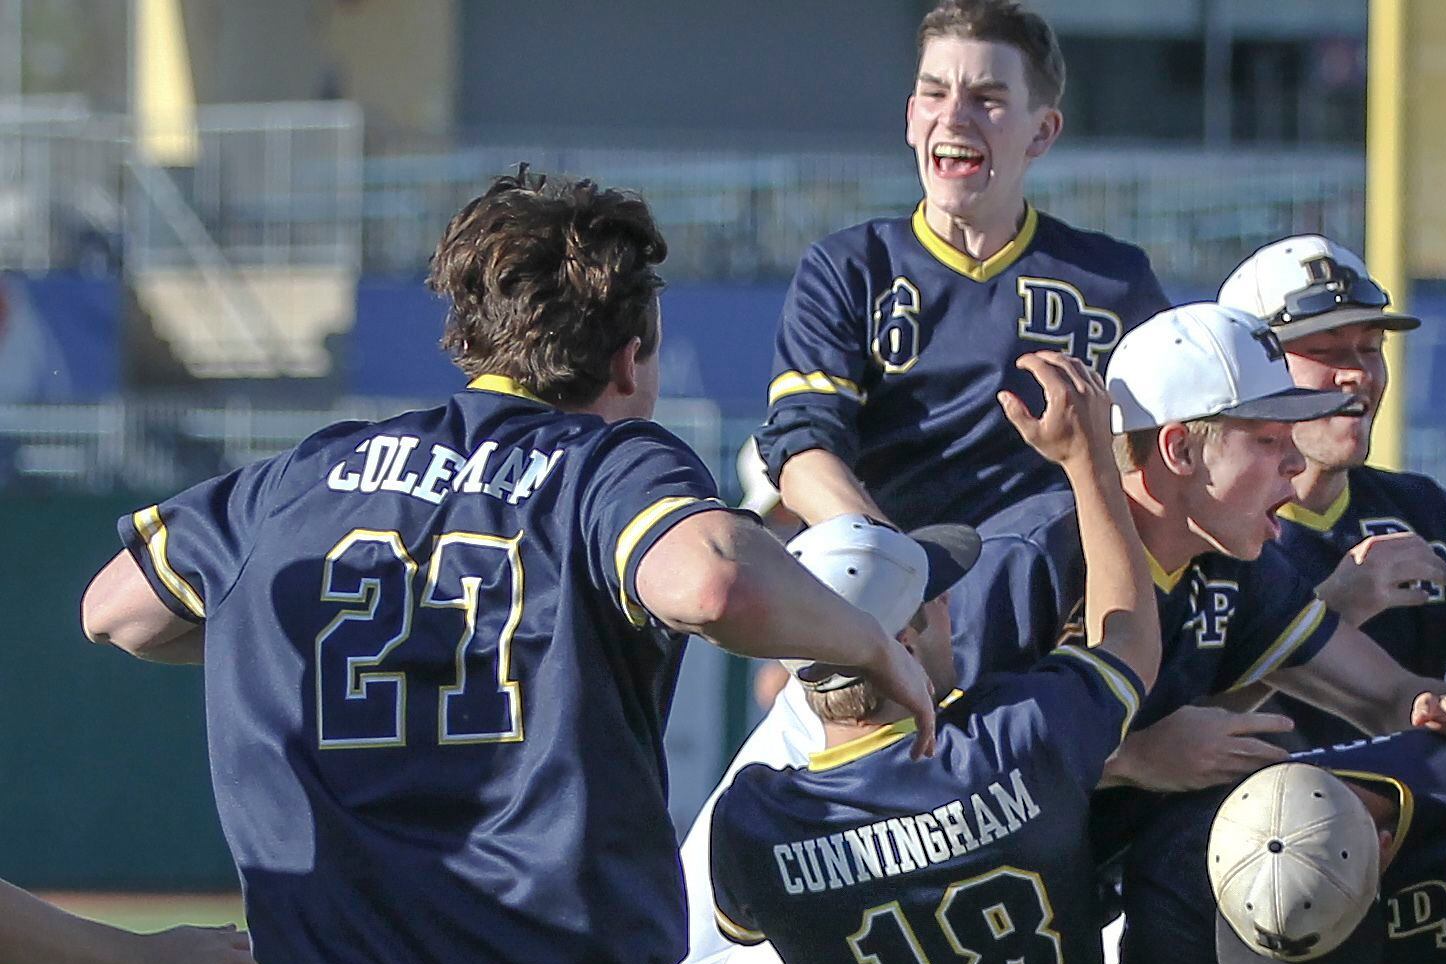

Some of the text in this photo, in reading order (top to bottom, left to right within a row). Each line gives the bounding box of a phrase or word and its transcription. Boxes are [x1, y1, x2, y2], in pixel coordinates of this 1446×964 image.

[872, 276, 921, 374] 6
[1017, 275, 1122, 371] DP
[315, 526, 525, 749] 27
[773, 768, 1042, 895] CUNNINGHAM
